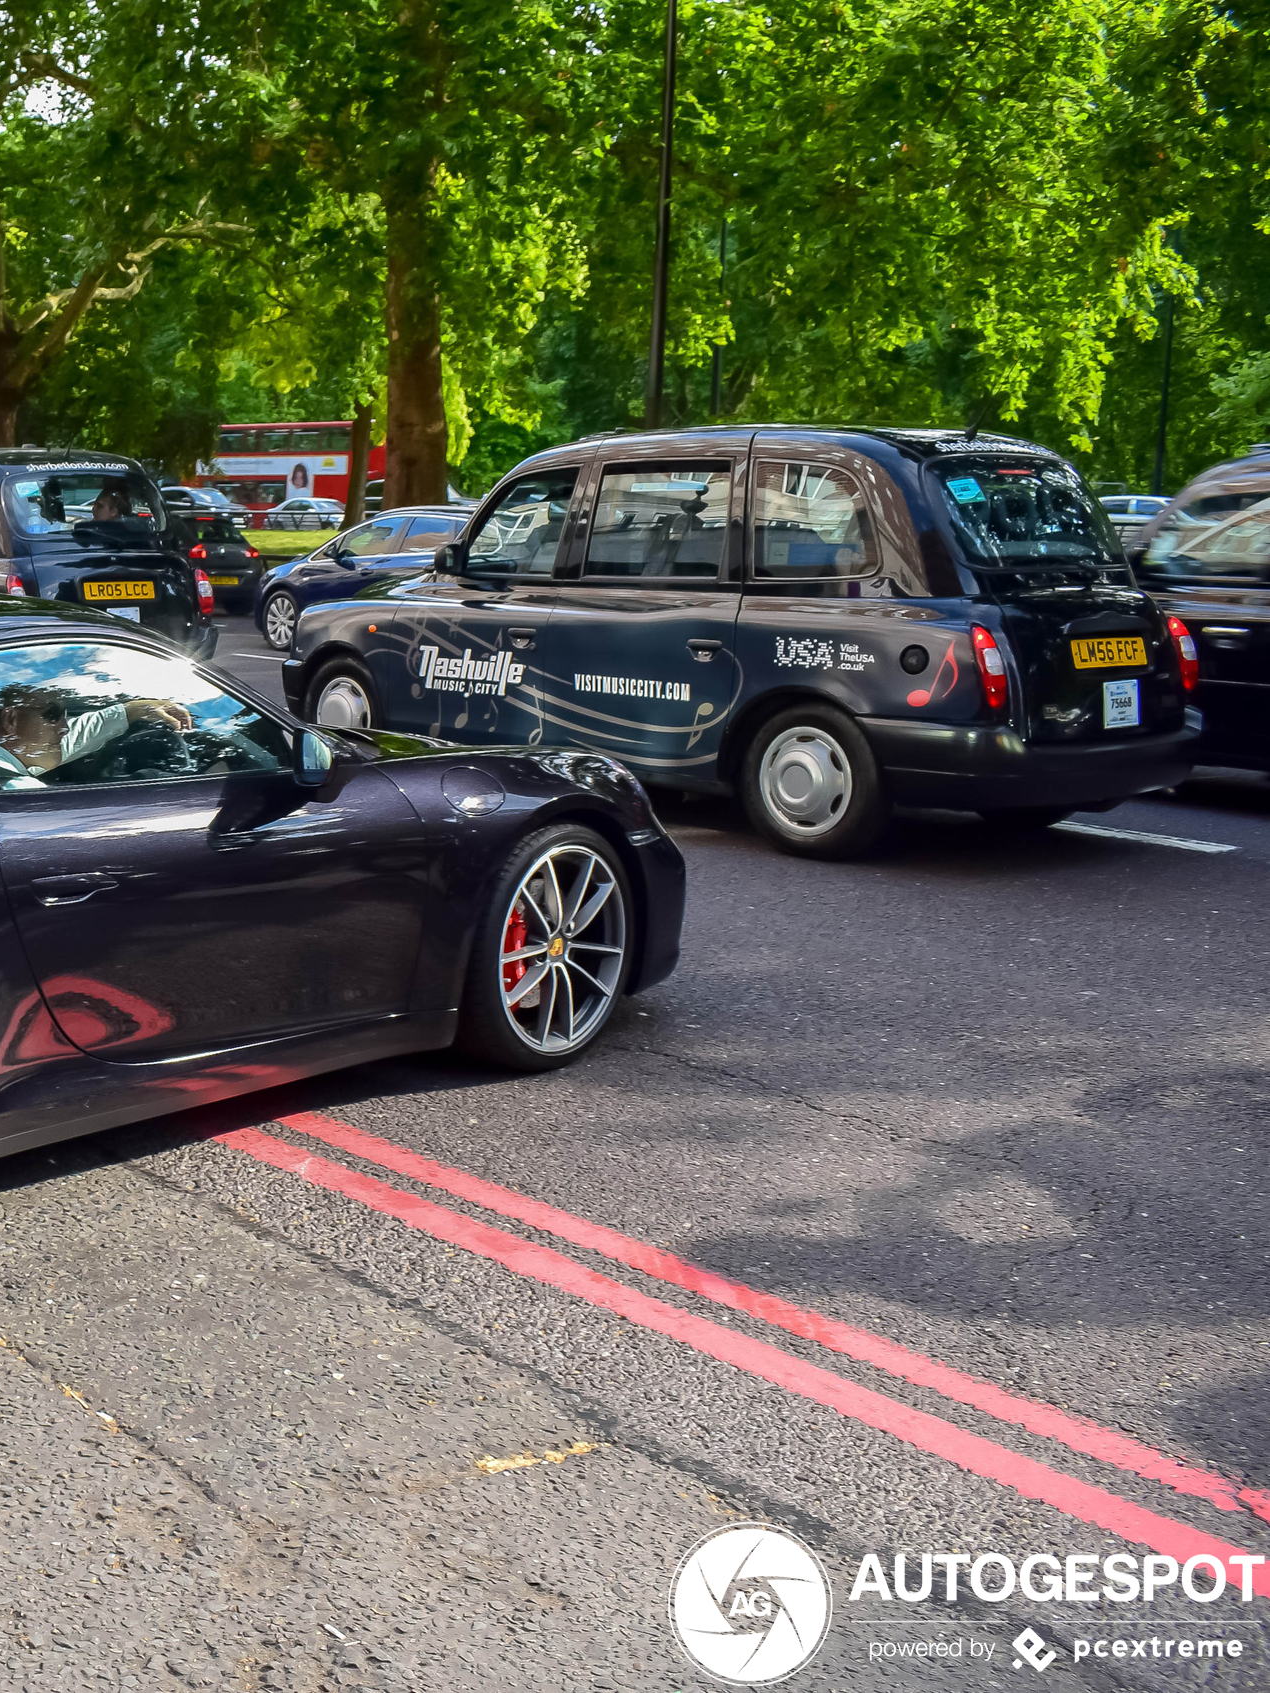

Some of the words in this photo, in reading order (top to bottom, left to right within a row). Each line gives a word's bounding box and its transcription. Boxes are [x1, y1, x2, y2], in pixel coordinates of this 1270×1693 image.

[26, 461, 129, 472] sherbetlondon.com
[89, 583, 122, 597] LR05
[125, 583, 149, 597] LCC
[773, 636, 834, 670] USA
[840, 643, 859, 653] Visit
[1076, 641, 1115, 663] LM56
[1116, 640, 1138, 661] FCF
[839, 652, 875, 663] TheUSA
[419, 645, 526, 696] Nashville
[837, 662, 865, 672] .co.uk
[433, 678, 465, 692] MUSIC
[474, 682, 498, 696] CITY
[574, 673, 690, 701] VISITMUSICCITY.COM
